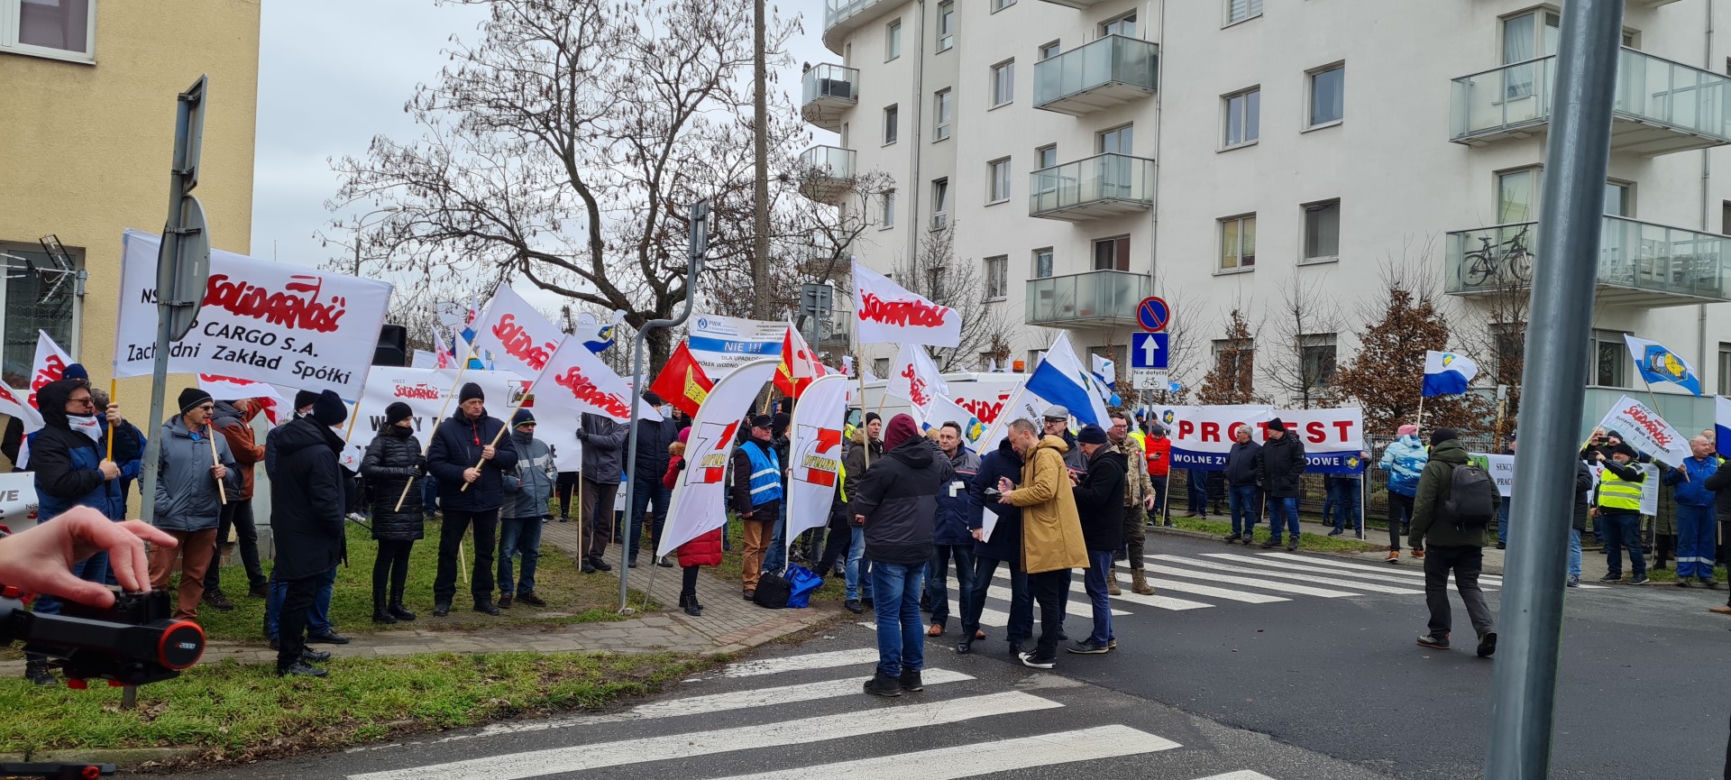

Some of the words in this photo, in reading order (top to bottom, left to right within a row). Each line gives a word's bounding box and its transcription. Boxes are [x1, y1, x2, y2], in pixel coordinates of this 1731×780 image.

[204, 321, 277, 347] CARGO
[281, 336, 319, 358] S.A.
[724, 342, 744, 352] NIE
[127, 341, 201, 362] Zachdni
[212, 345, 283, 371] Zakład
[292, 360, 352, 385] Spółki
[1174, 454, 1212, 465] WOLNE
